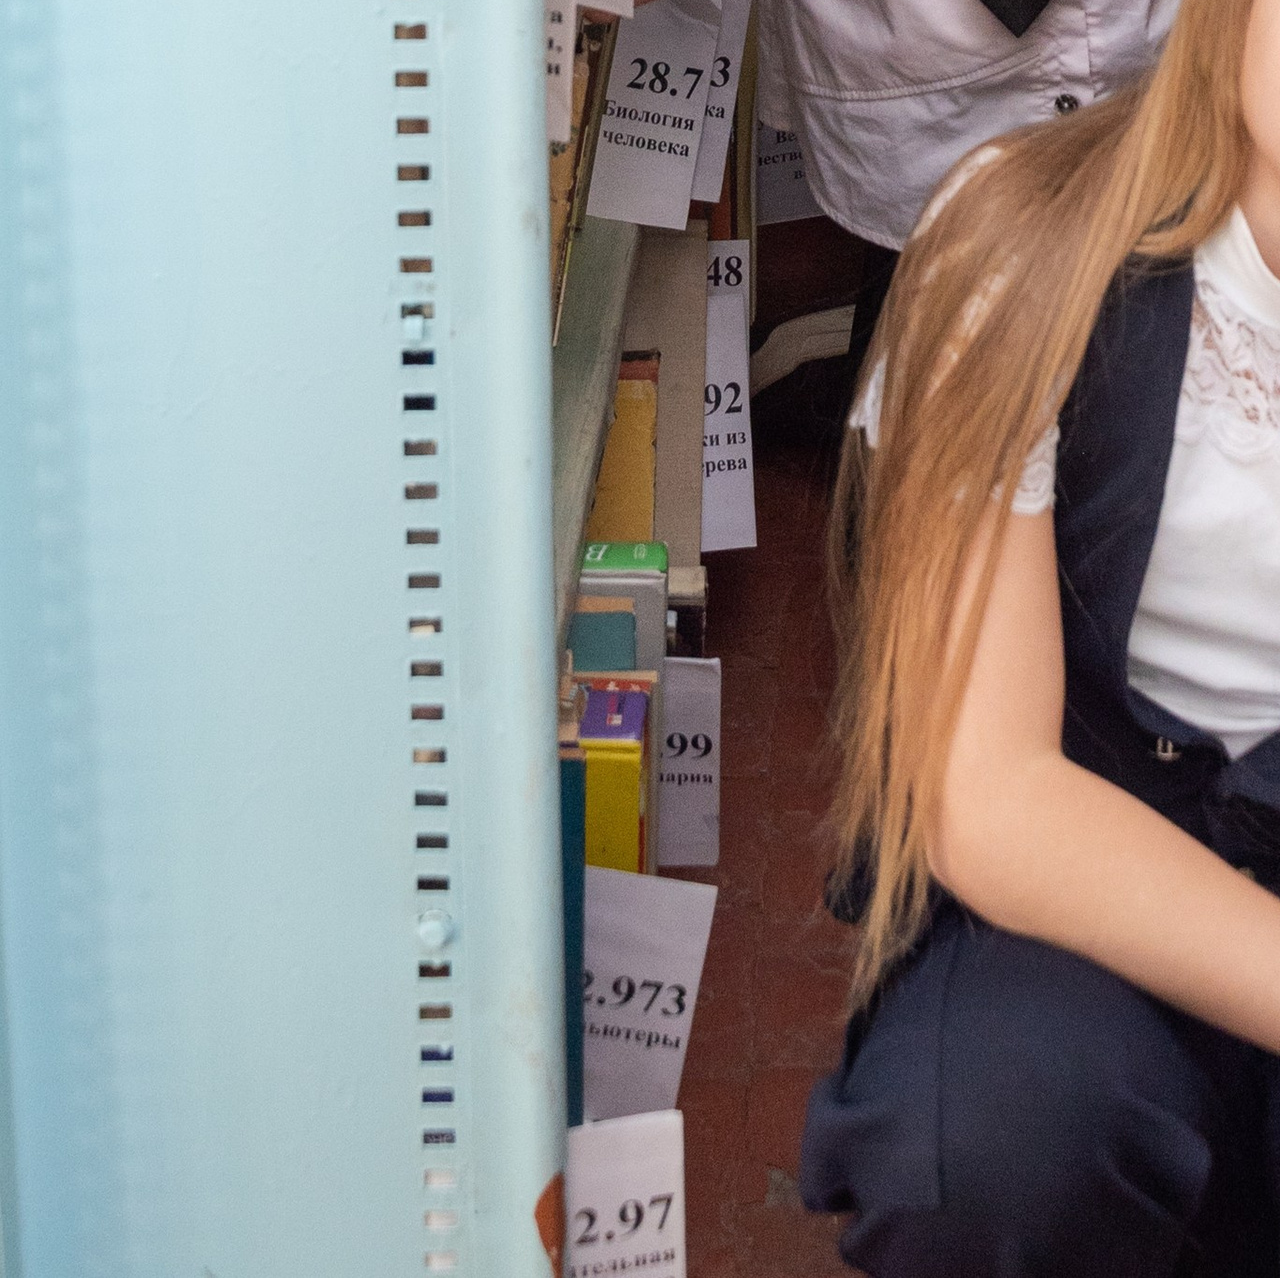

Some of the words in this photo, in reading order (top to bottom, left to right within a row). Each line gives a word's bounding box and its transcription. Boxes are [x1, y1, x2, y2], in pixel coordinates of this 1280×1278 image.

[627, 57, 703, 99] 28.7
[603, 99, 695, 131] Биология
[603, 128, 690, 157] человека
[704, 382, 743, 417] 92
[726, 432, 746, 445] из
[575, 1193, 674, 1246] 2.97
